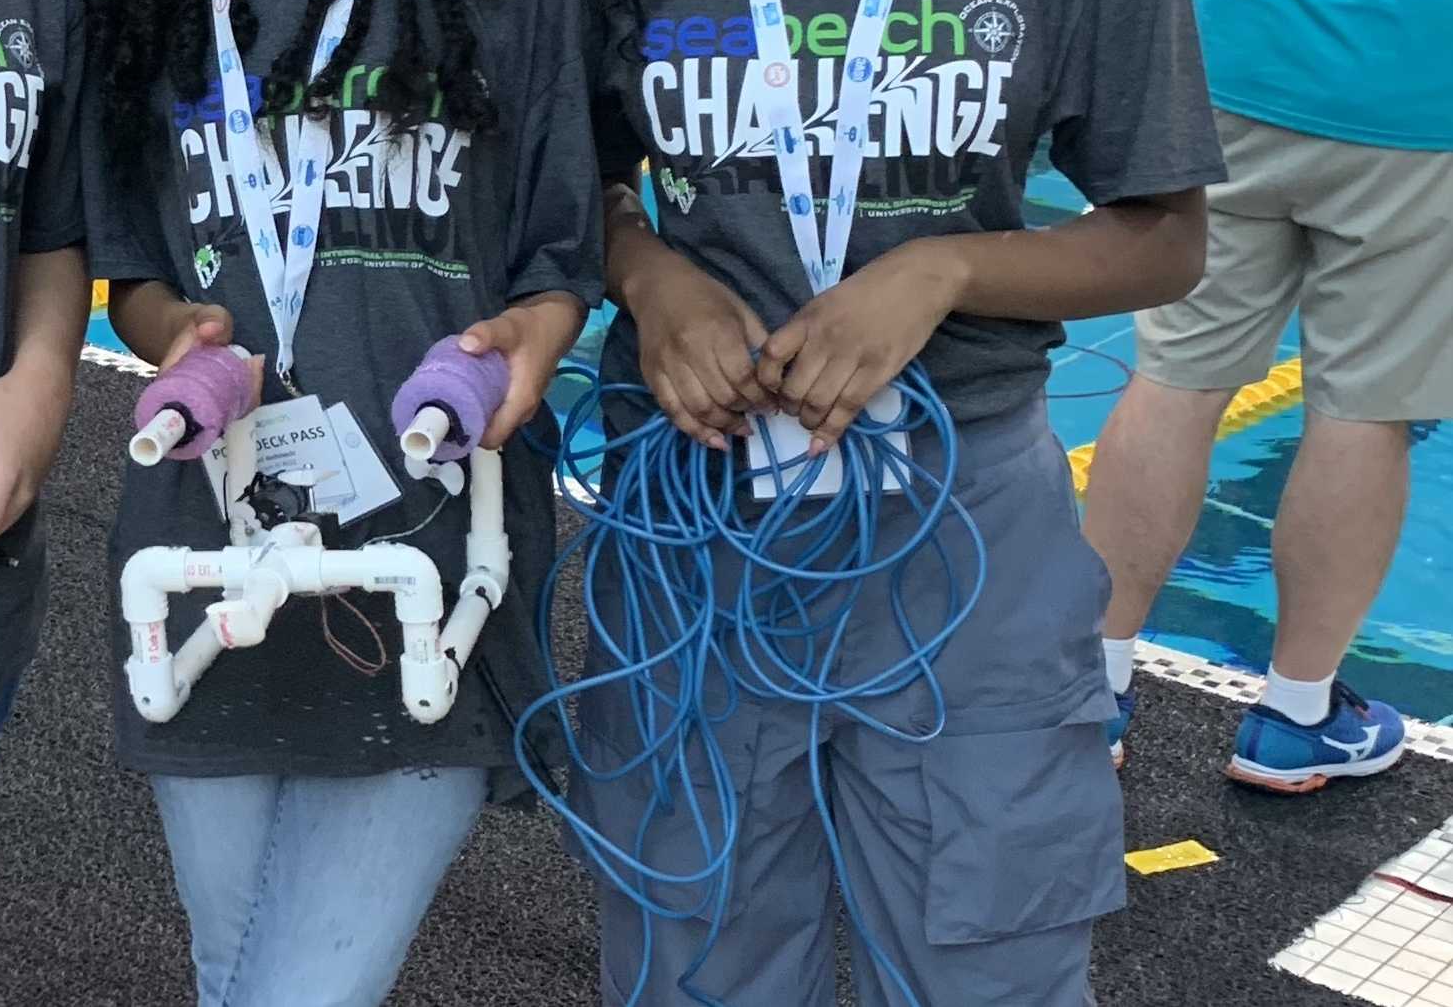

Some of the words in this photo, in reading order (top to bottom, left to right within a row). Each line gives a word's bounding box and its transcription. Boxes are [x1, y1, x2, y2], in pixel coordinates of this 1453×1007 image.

[180, 109, 471, 225] CHALENGE
[867, 206, 929, 218] UNIVERSITY
[290, 426, 326, 444] PASS
